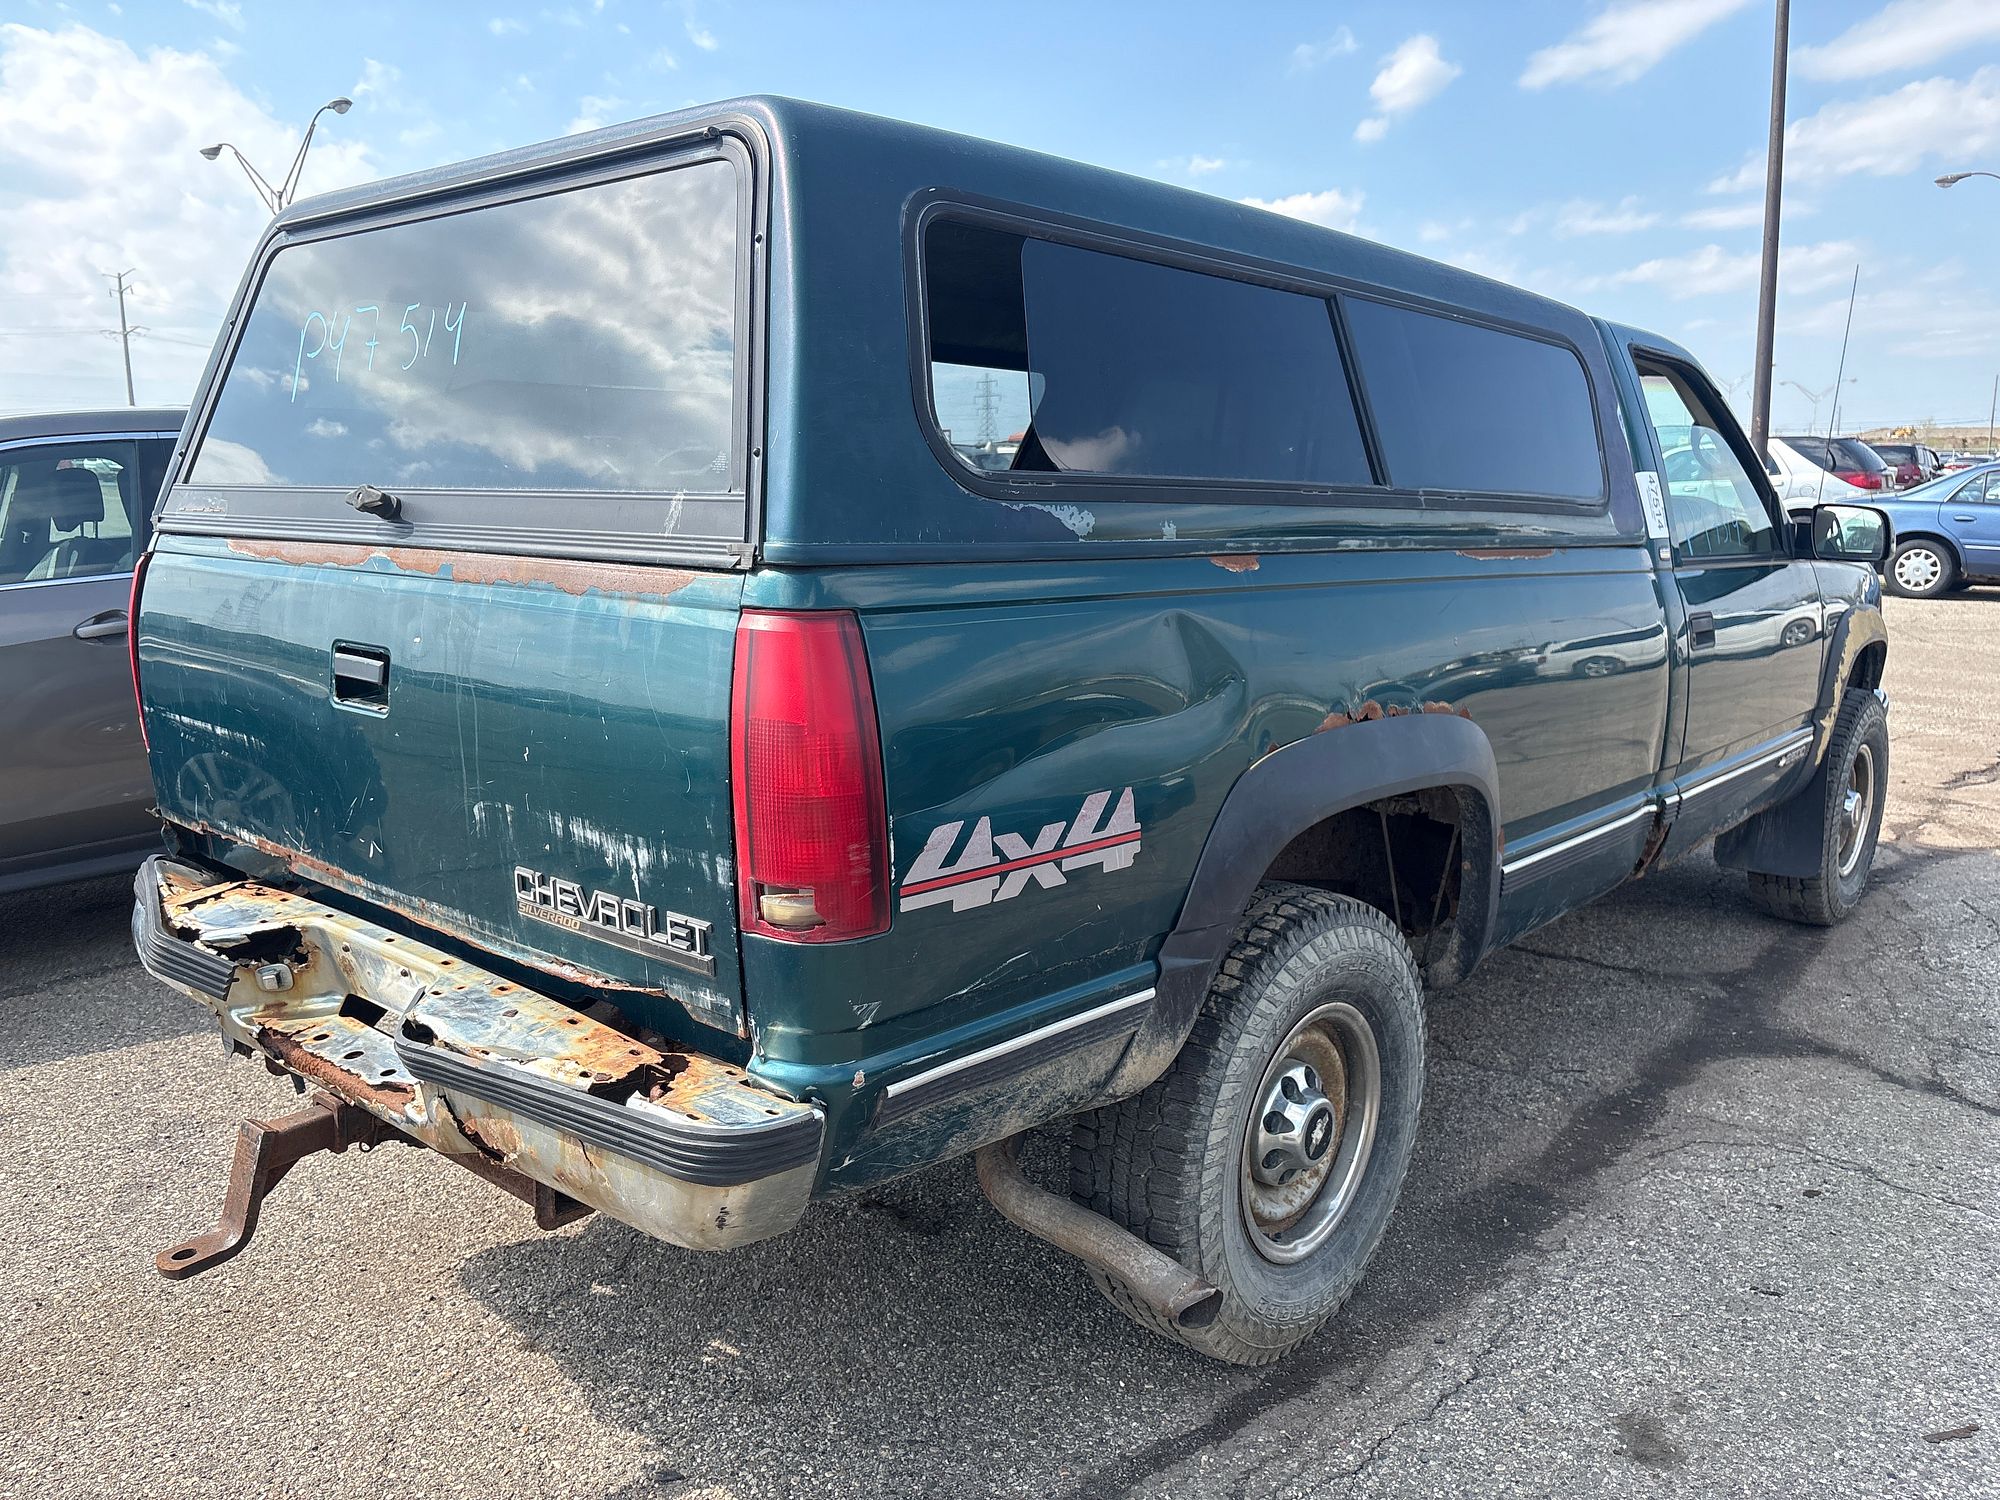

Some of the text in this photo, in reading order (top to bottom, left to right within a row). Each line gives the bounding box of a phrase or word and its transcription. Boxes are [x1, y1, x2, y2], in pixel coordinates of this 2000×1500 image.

[899, 786, 1142, 913] 4x4
[514, 865, 714, 957] CHEVROLET
[517, 900, 582, 931] SILVERADO
